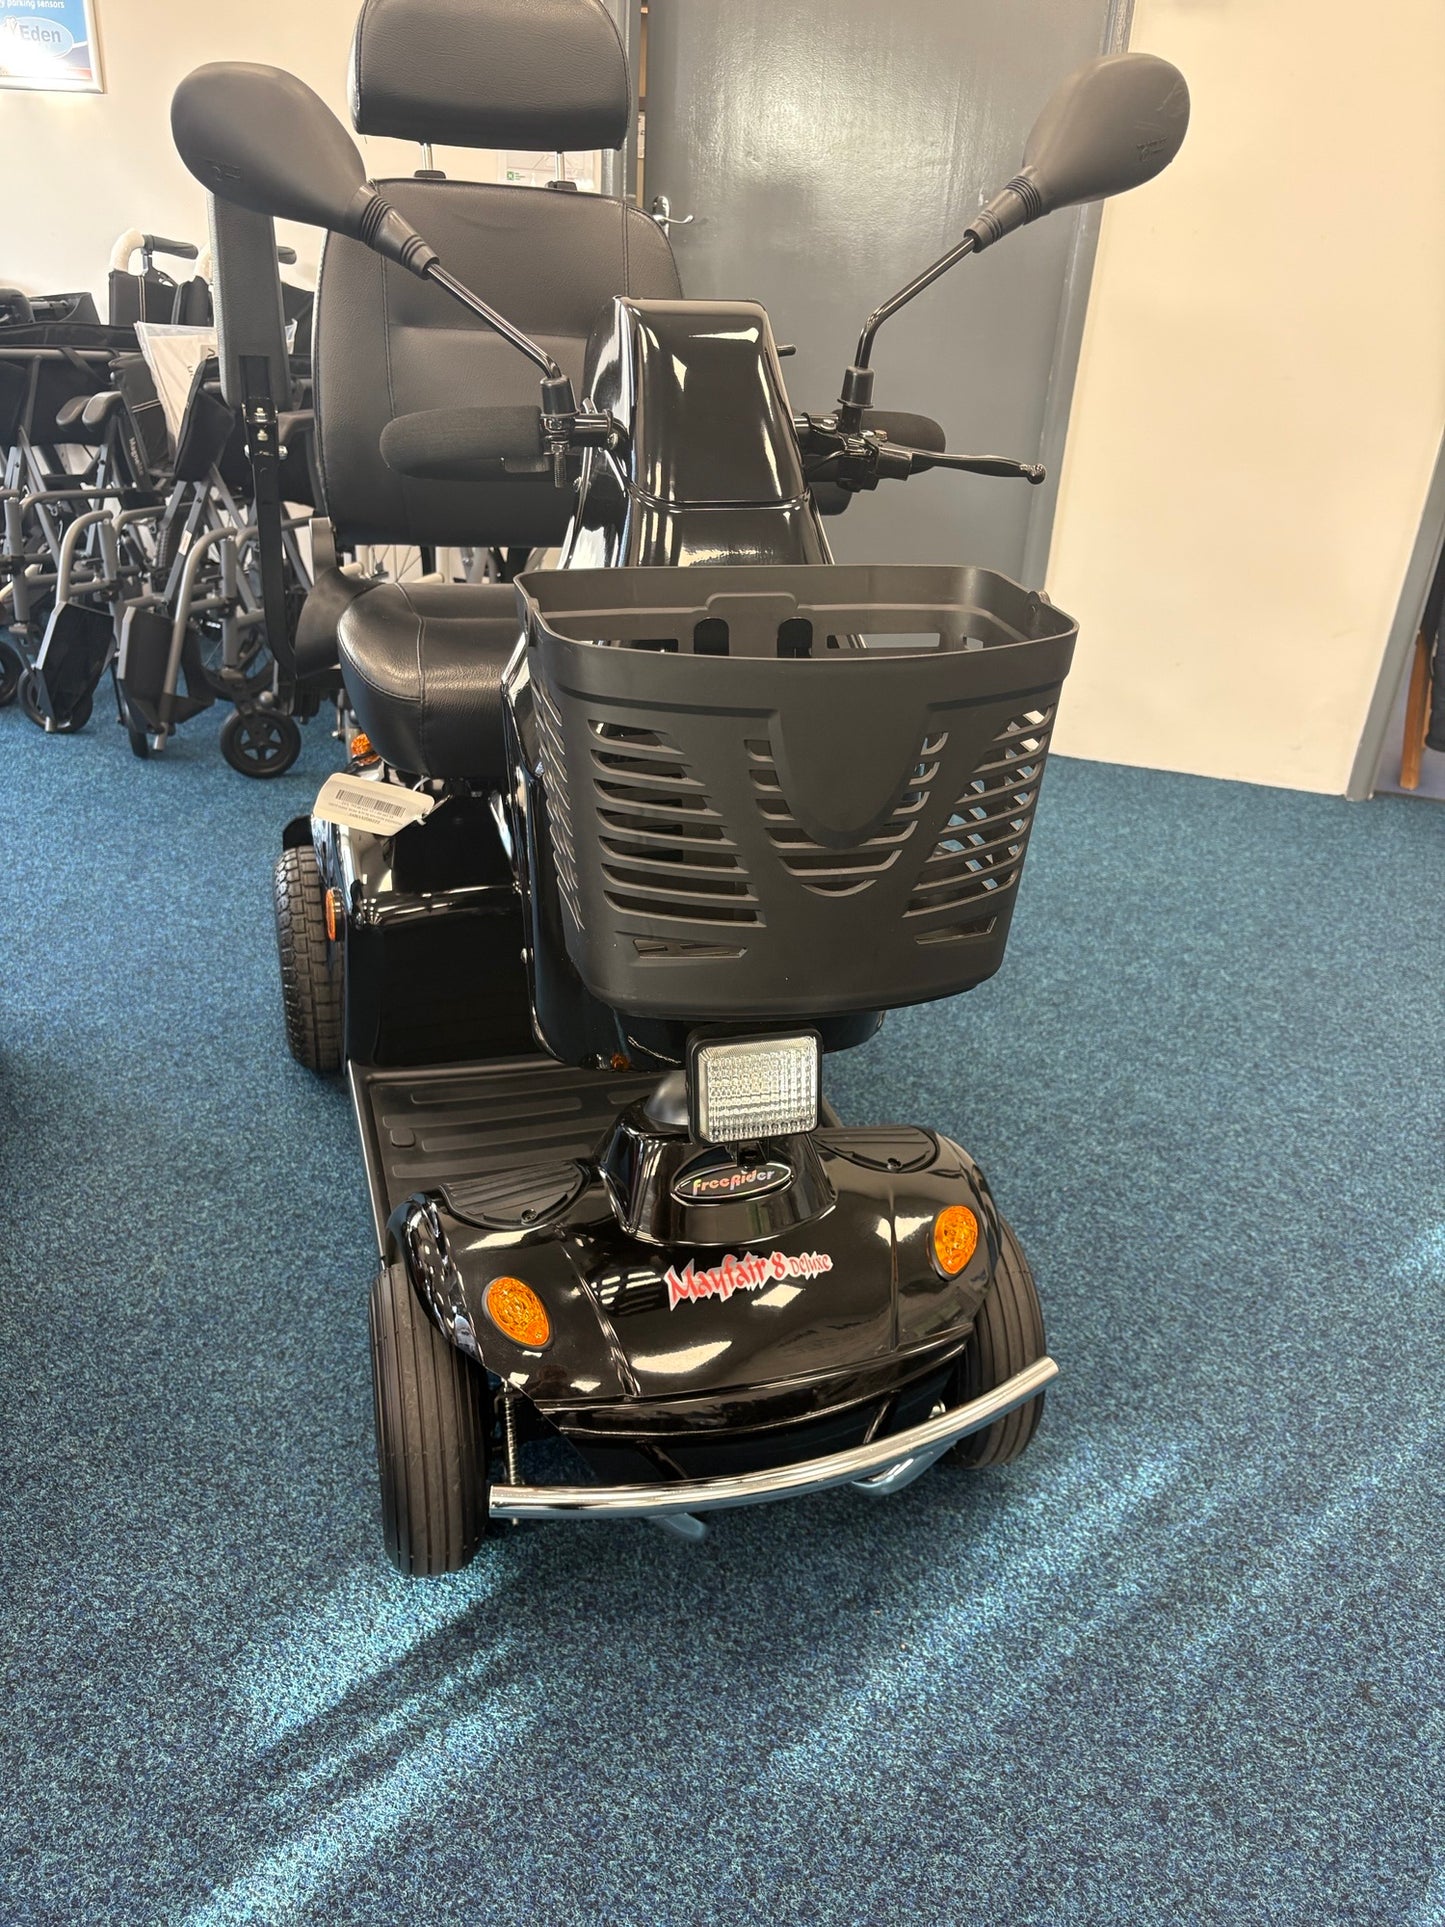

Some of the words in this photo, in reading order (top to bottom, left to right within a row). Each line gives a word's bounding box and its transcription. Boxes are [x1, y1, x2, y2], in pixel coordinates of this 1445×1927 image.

[19, 25, 61, 42] Eden
[693, 1169, 775, 1196] FreeRider
[666, 1253, 767, 1304] Mayfair
[771, 1252, 786, 1279] 8
[789, 1254, 831, 1276] Deluxe
